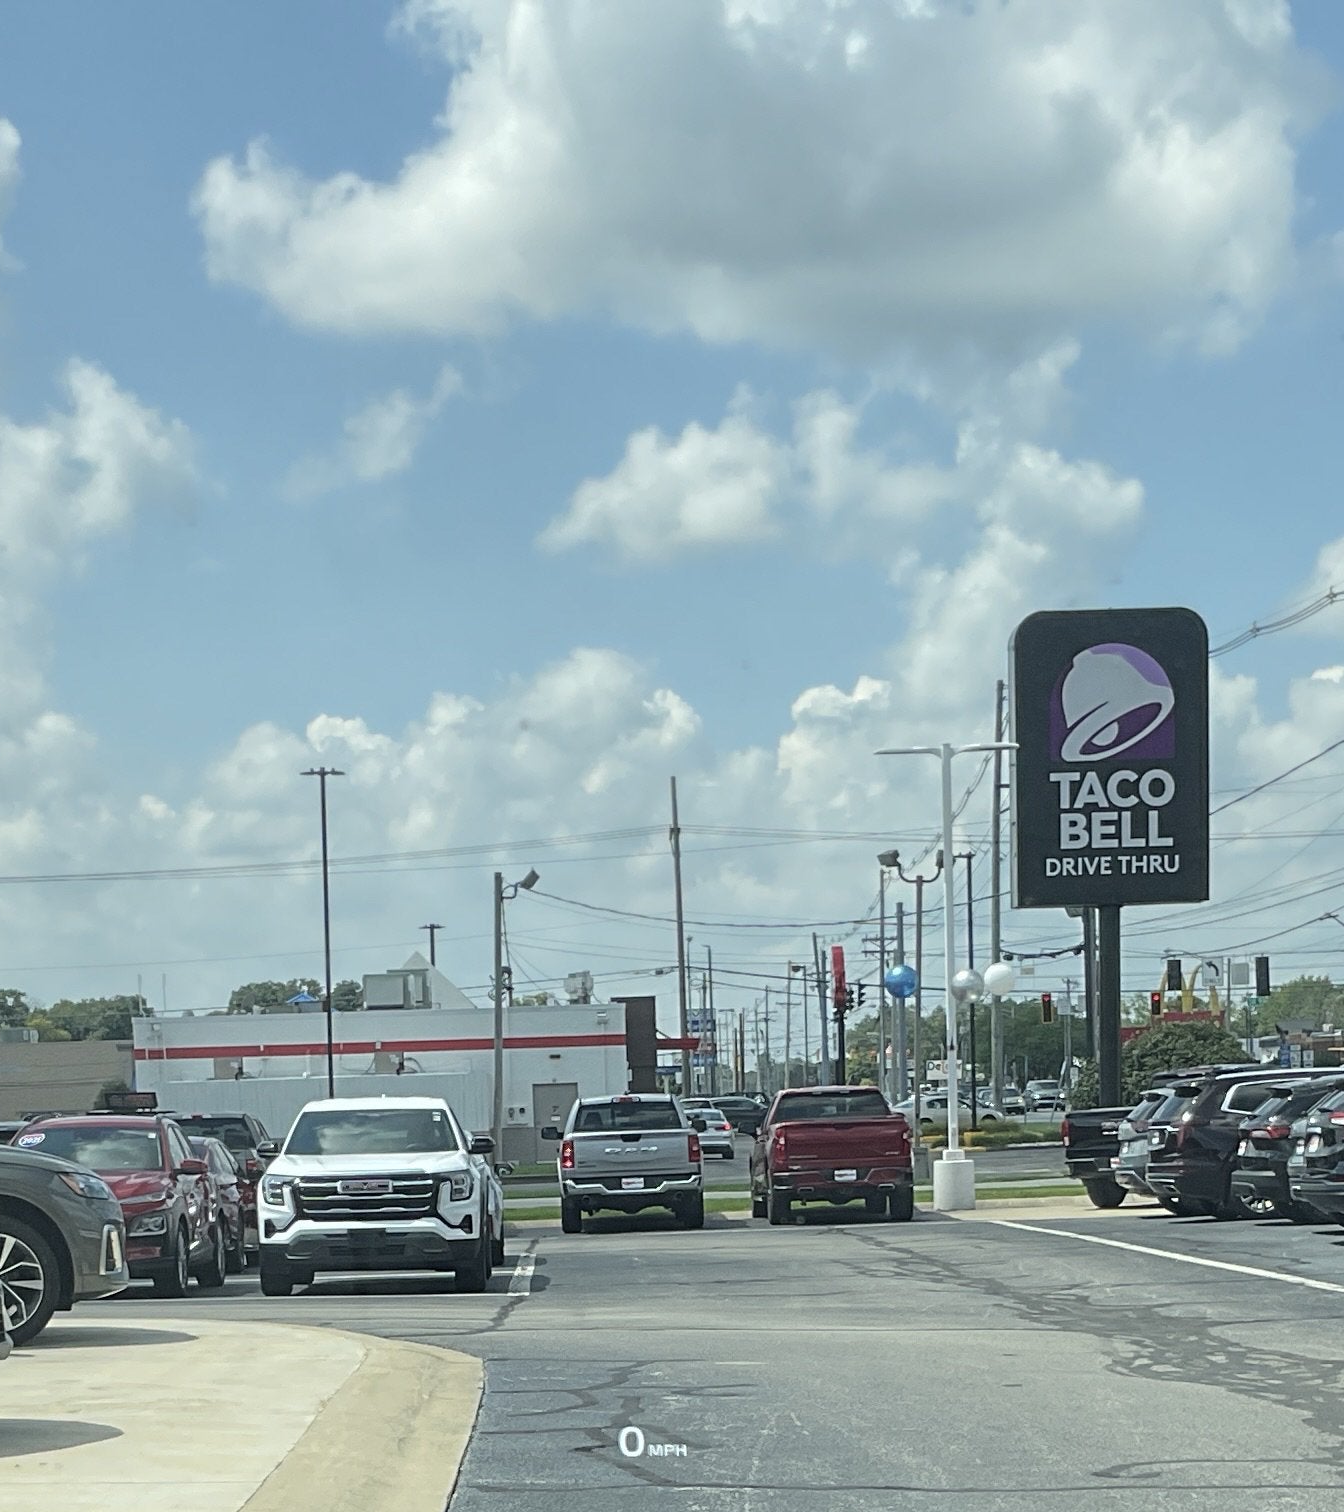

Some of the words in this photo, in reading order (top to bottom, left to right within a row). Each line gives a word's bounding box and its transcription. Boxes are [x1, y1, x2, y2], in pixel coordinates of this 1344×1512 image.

[1049, 768, 1176, 810] TACO
[1059, 810, 1174, 850] BELL
[1045, 856, 1112, 877] DRIVE
[1117, 854, 1180, 875] THRU
[618, 1425, 645, 1458] 0
[647, 1443, 688, 1457] MPH
